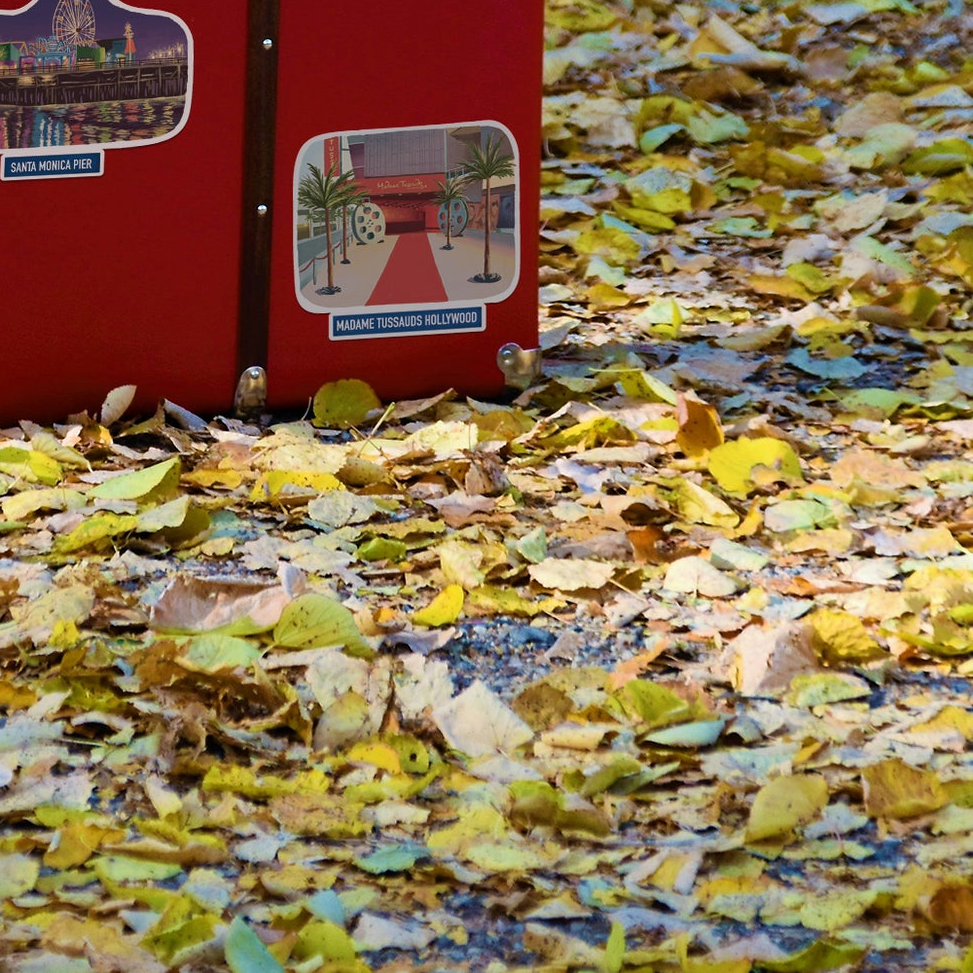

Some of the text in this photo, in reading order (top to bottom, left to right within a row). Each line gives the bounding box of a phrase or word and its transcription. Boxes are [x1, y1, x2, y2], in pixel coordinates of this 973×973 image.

[10, 158, 93, 173] SANTA MONICA PIER
[336, 311, 478, 331] MADAME TUSSAUDS HOLLYWOOD
